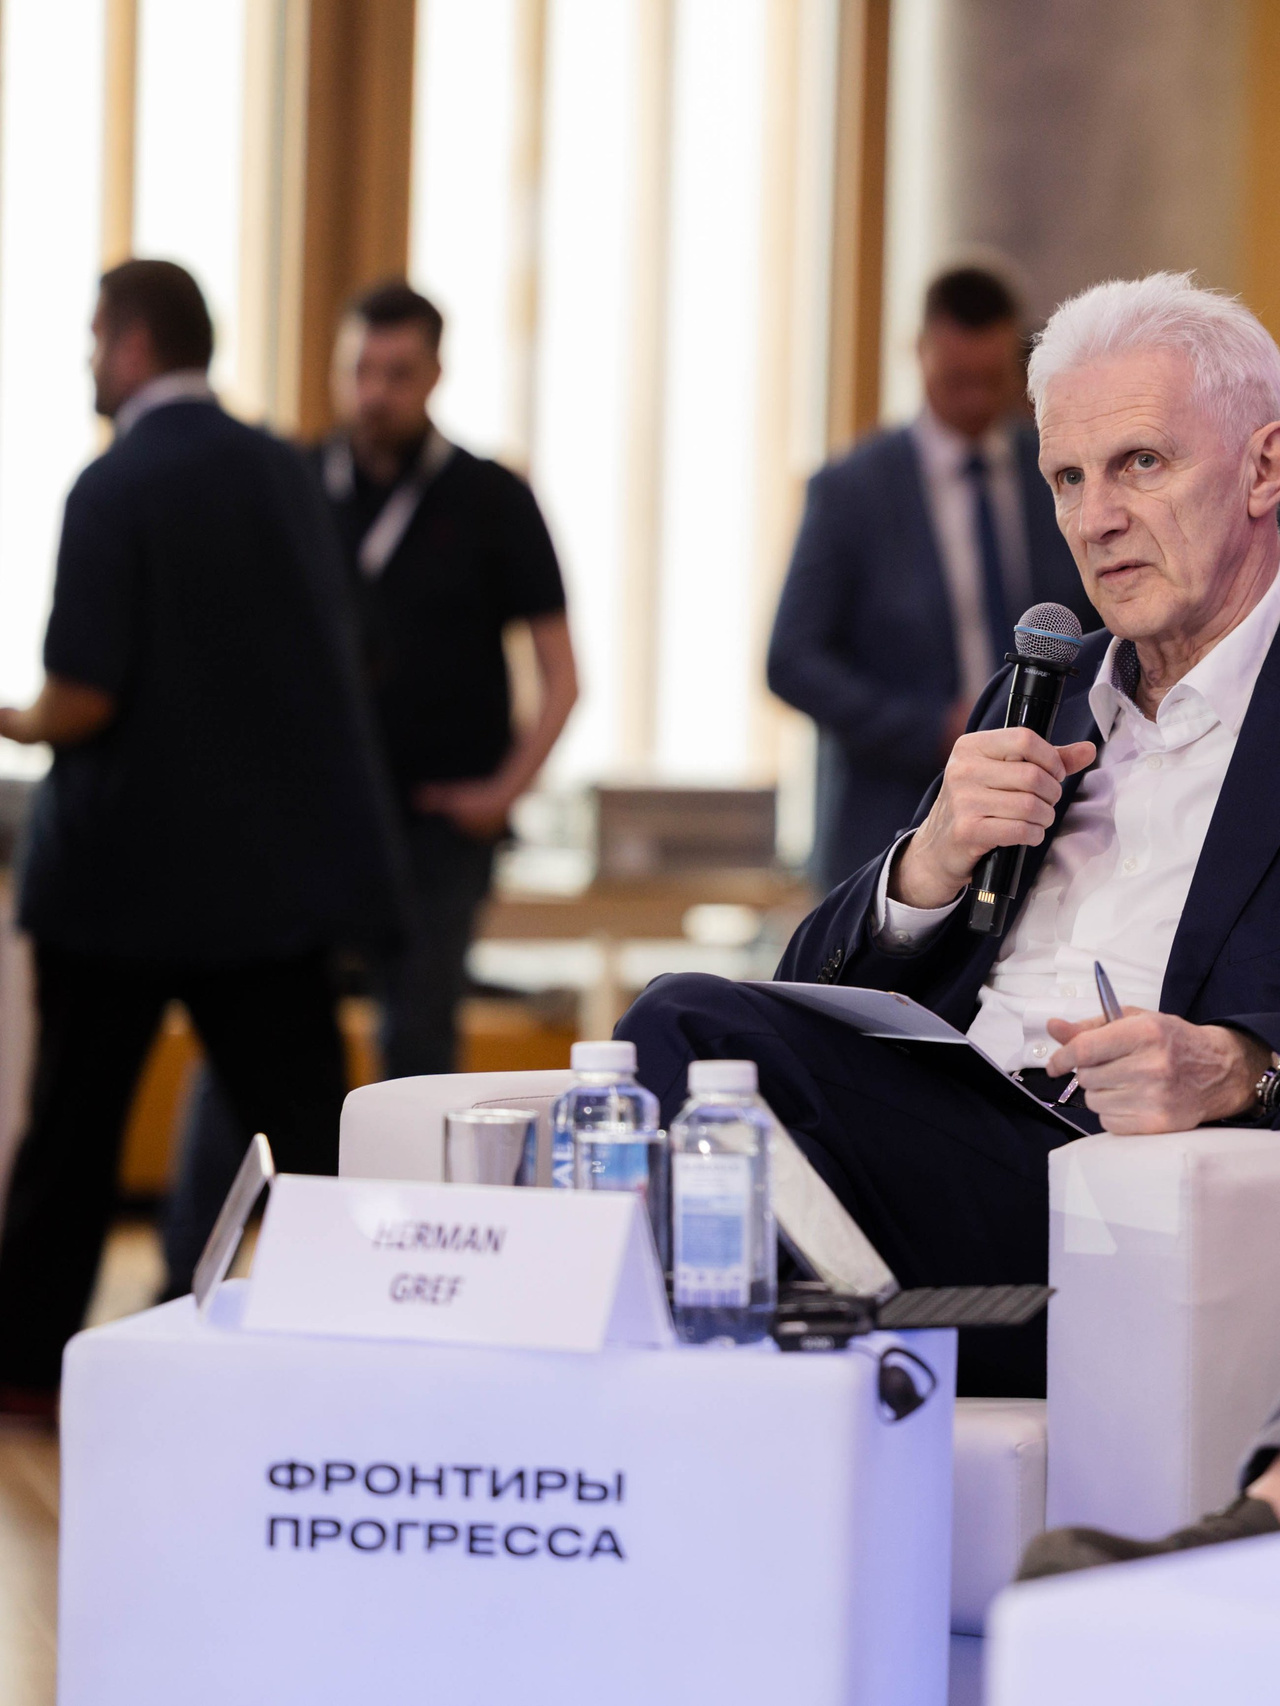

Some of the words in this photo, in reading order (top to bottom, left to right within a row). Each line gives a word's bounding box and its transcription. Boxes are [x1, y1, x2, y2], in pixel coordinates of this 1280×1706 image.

[388, 1272, 465, 1305] GREF
[266, 1459, 626, 1503] ФРОНТИРЫ
[266, 1516, 626, 1560] ПРОГРЕССА
